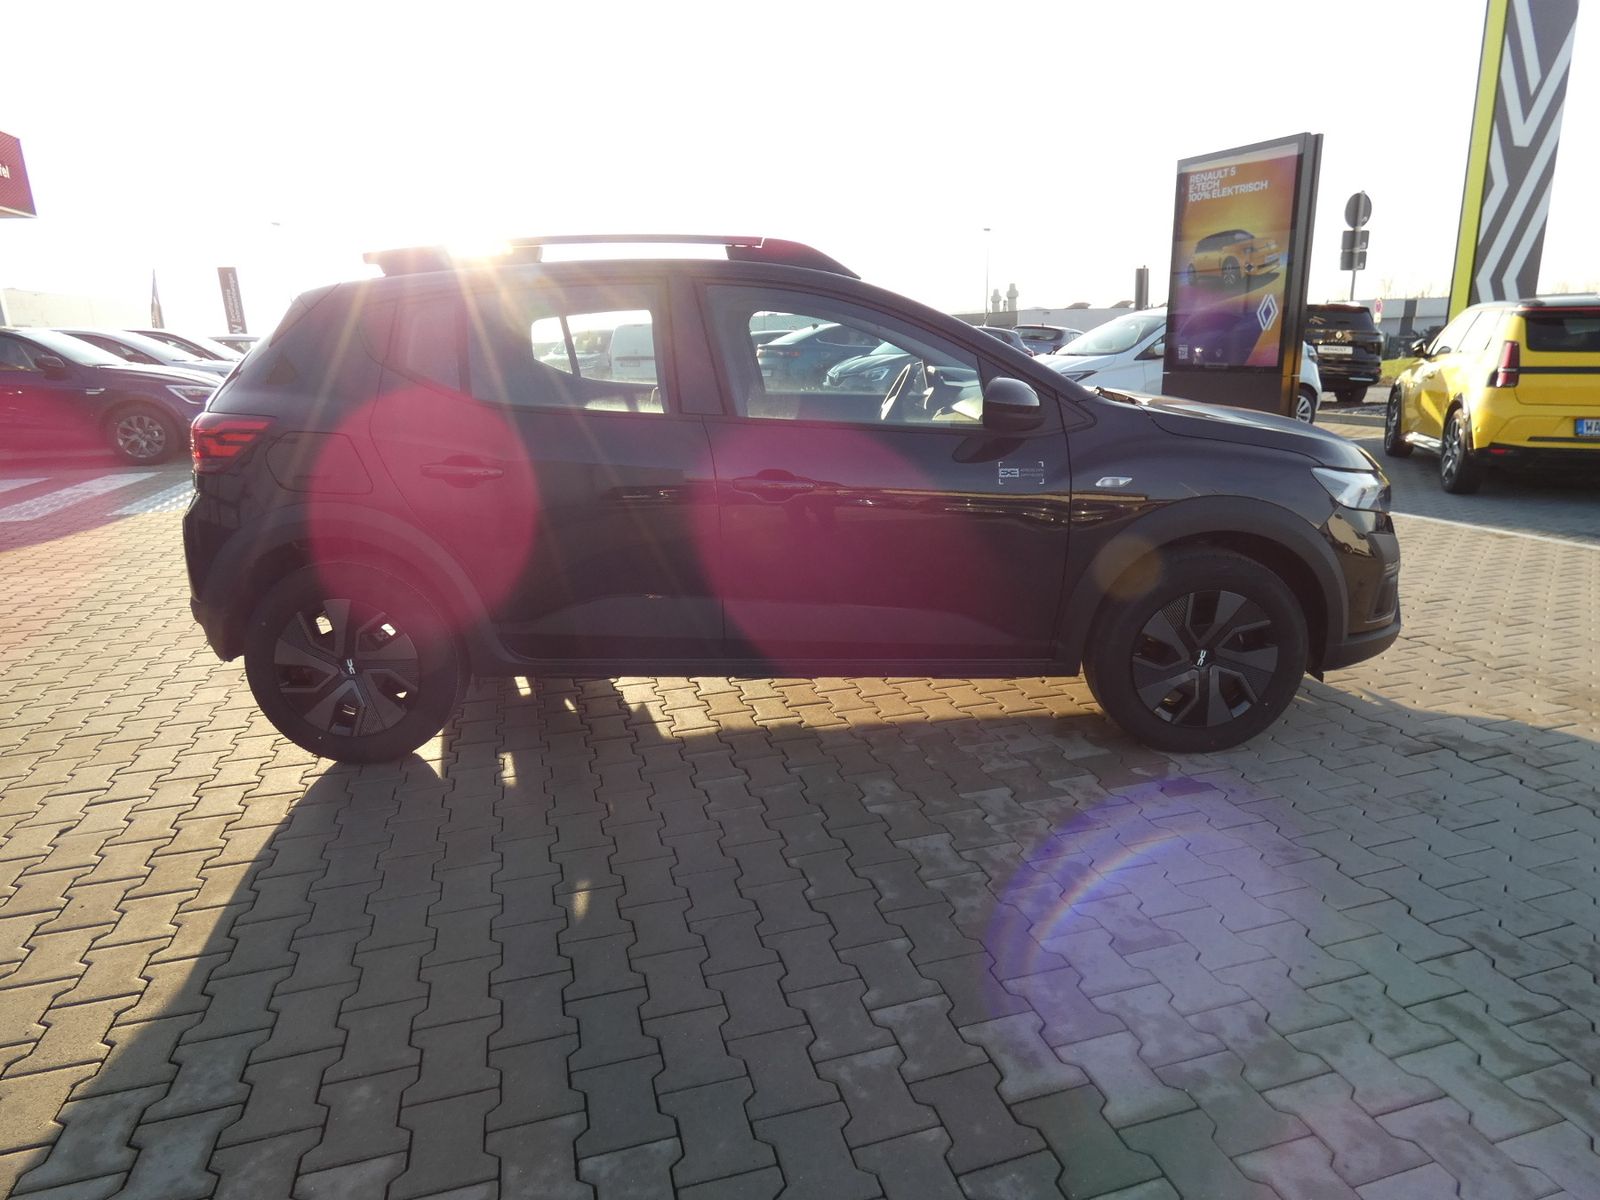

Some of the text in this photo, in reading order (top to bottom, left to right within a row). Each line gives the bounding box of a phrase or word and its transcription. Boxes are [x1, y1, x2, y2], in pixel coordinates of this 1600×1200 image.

[1190, 168, 1230, 184] RENAULT
[1188, 180, 1268, 202] 100% ELEKTRISCH
[1189, 180, 1220, 193] E-TECH
